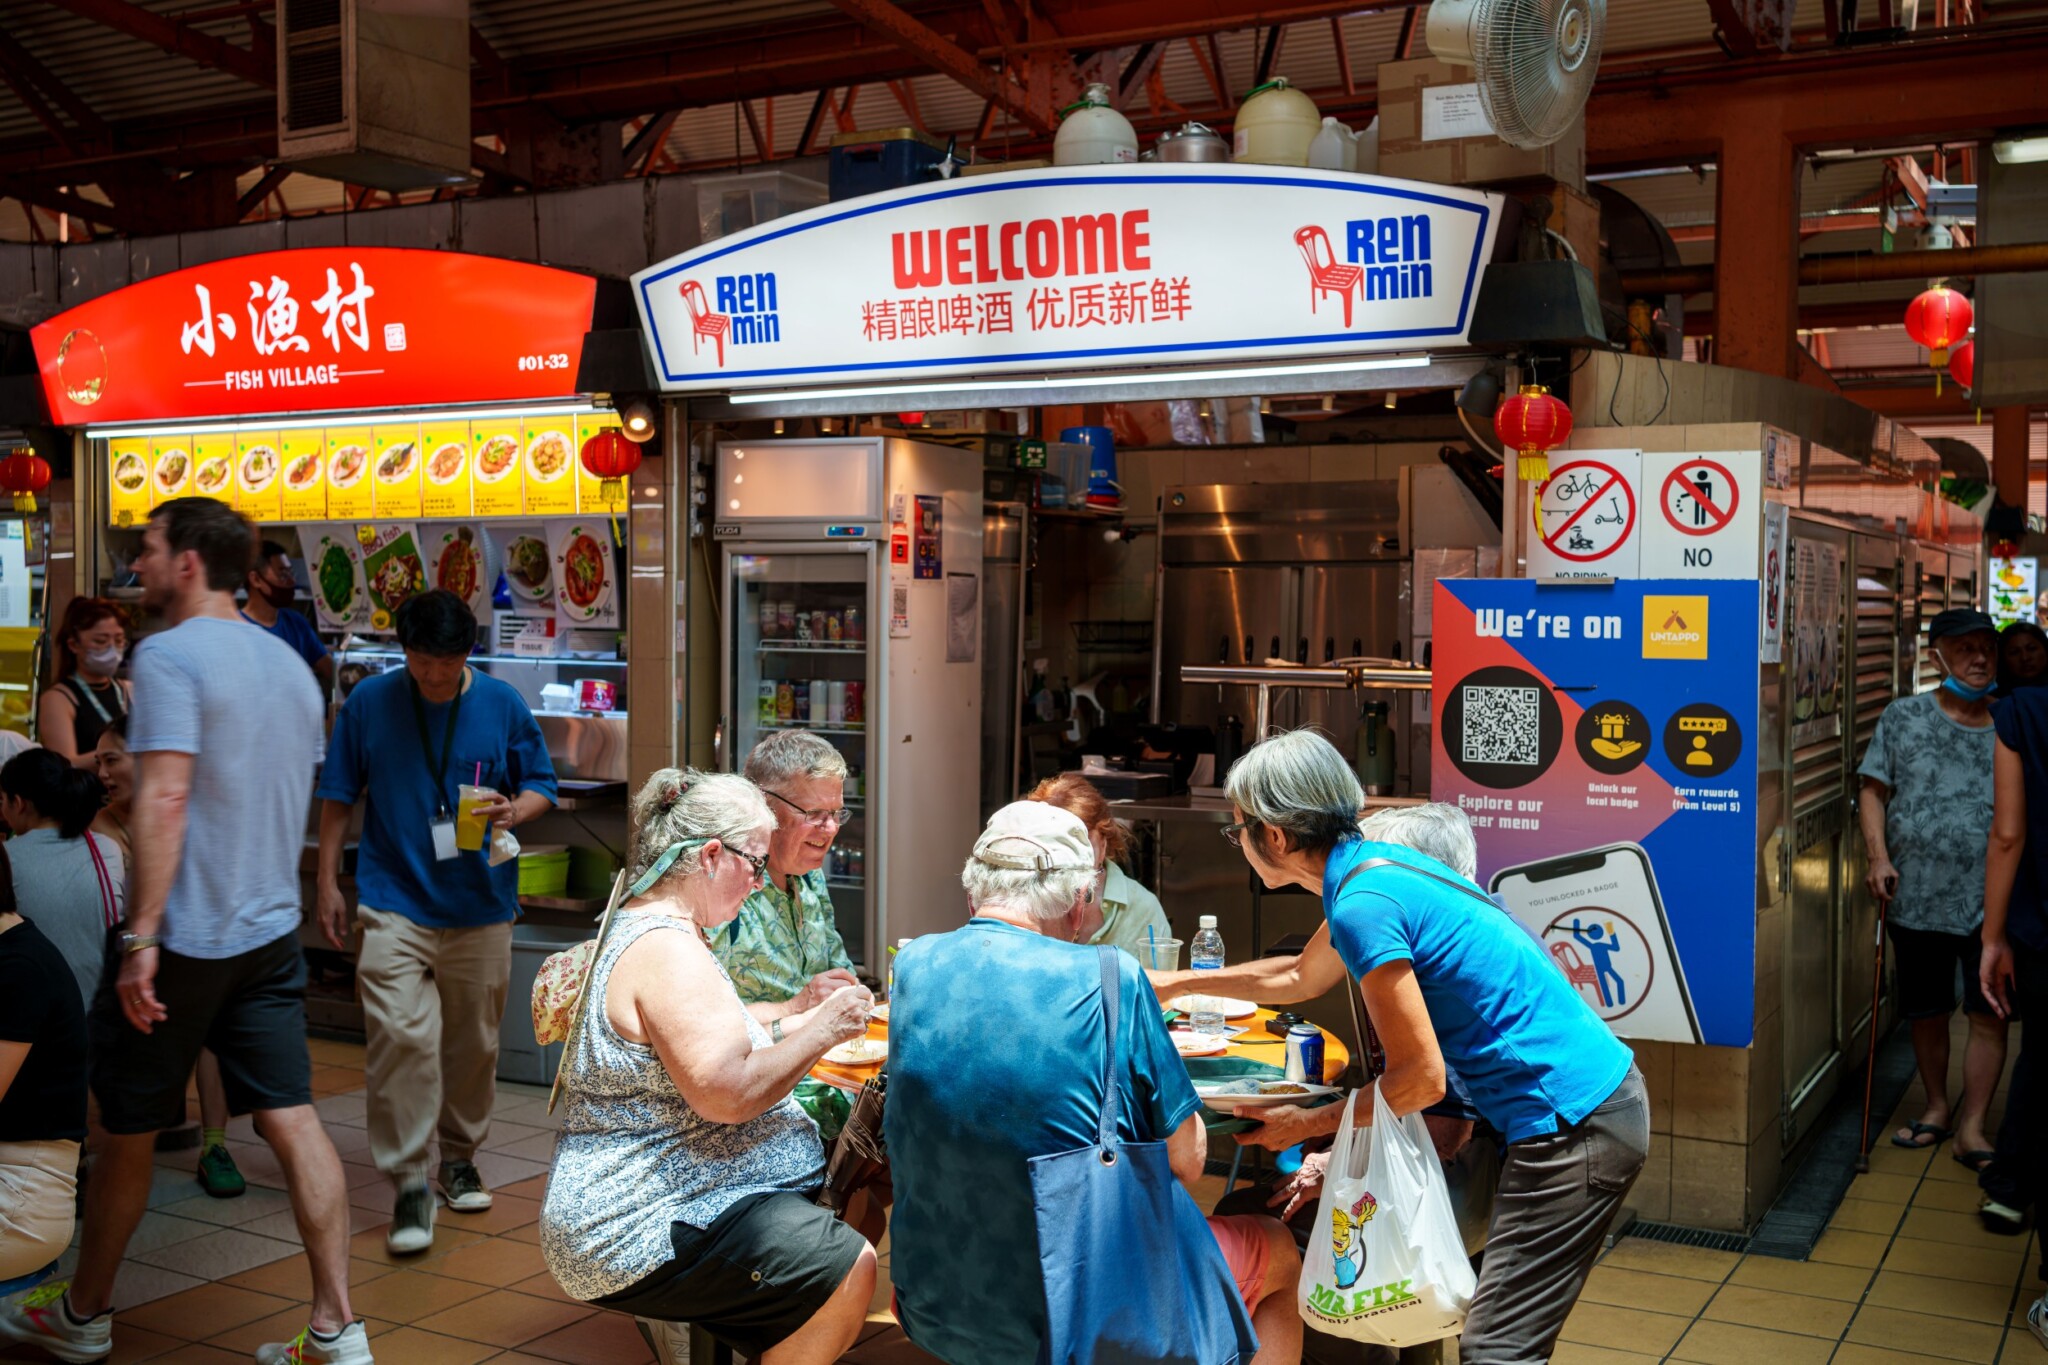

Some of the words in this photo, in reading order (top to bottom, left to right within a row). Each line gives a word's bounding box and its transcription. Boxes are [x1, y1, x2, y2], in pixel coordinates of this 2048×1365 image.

[892, 209, 1151, 290] WELCOME
[1346, 214, 1431, 266] Ren
[1365, 261, 1433, 302] min
[717, 272, 777, 314] Ren
[862, 290, 1013, 342] 精酿啤酒
[1026, 276, 1192, 330] 优质新鲜
[731, 310, 780, 345] min
[518, 353, 569, 371] #01-32
[225, 370, 264, 391] FISH
[269, 364, 340, 388] VILLAGE
[382, 525, 401, 542] fish
[1684, 548, 1713, 567] NO
[1475, 608, 1571, 639] We're
[1583, 615, 1622, 639] on
[1650, 632, 1700, 642] UNTAPPD
[1588, 782, 1619, 794] Unlock
[1621, 785, 1638, 794] our
[1674, 786, 1696, 797] Earn
[1699, 788, 1739, 798] rewards
[1458, 794, 1513, 812] Explore
[1518, 800, 1544, 812] our
[1586, 796, 1608, 807] local
[1610, 797, 1639, 809] badge
[1672, 799, 1699, 811] (from
[1702, 801, 1727, 811] Level
[1730, 802, 1741, 813] 5)
[1469, 815, 1494, 828] eer
[1499, 817, 1540, 830] menu
[1528, 898, 1544, 907] YOU
[1546, 889, 1585, 904] UNLOCKED
[1594, 882, 1619, 893] BADGE
[1353, 1279, 1414, 1312] FIX
